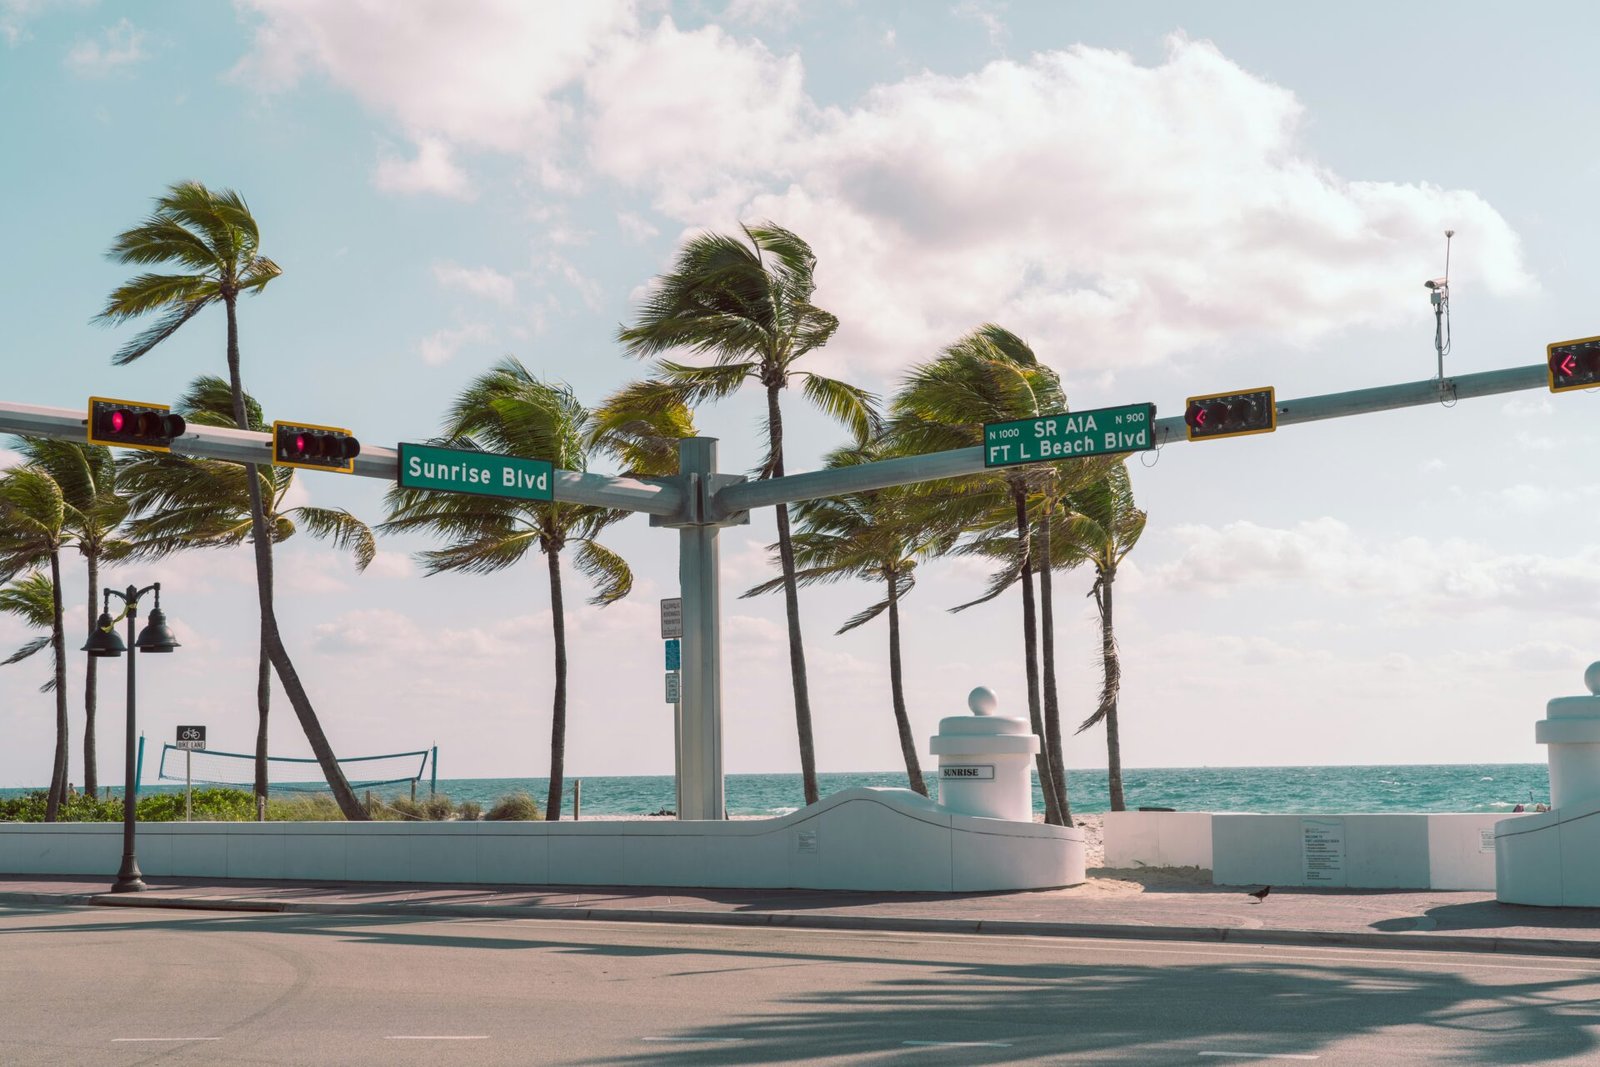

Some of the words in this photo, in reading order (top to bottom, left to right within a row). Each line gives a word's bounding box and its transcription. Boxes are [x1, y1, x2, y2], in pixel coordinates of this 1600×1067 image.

[1115, 415, 1122, 424] N
[1126, 412, 1145, 422] 900
[1034, 420, 1057, 438] SR
[1065, 415, 1098, 434] A1A
[989, 431, 996, 440] N
[999, 428, 1020, 439] 1000
[990, 444, 1011, 463] FT
[1020, 443, 1031, 459] L
[1040, 436, 1094, 457] Beach
[1105, 429, 1146, 449] Blvd
[409, 456, 491, 485] Sunrise
[502, 467, 547, 491] Blvd
[178, 741, 190, 749] BIKE
[191, 741, 204, 749] LANE
[944, 768, 979, 777] SUNRISE
